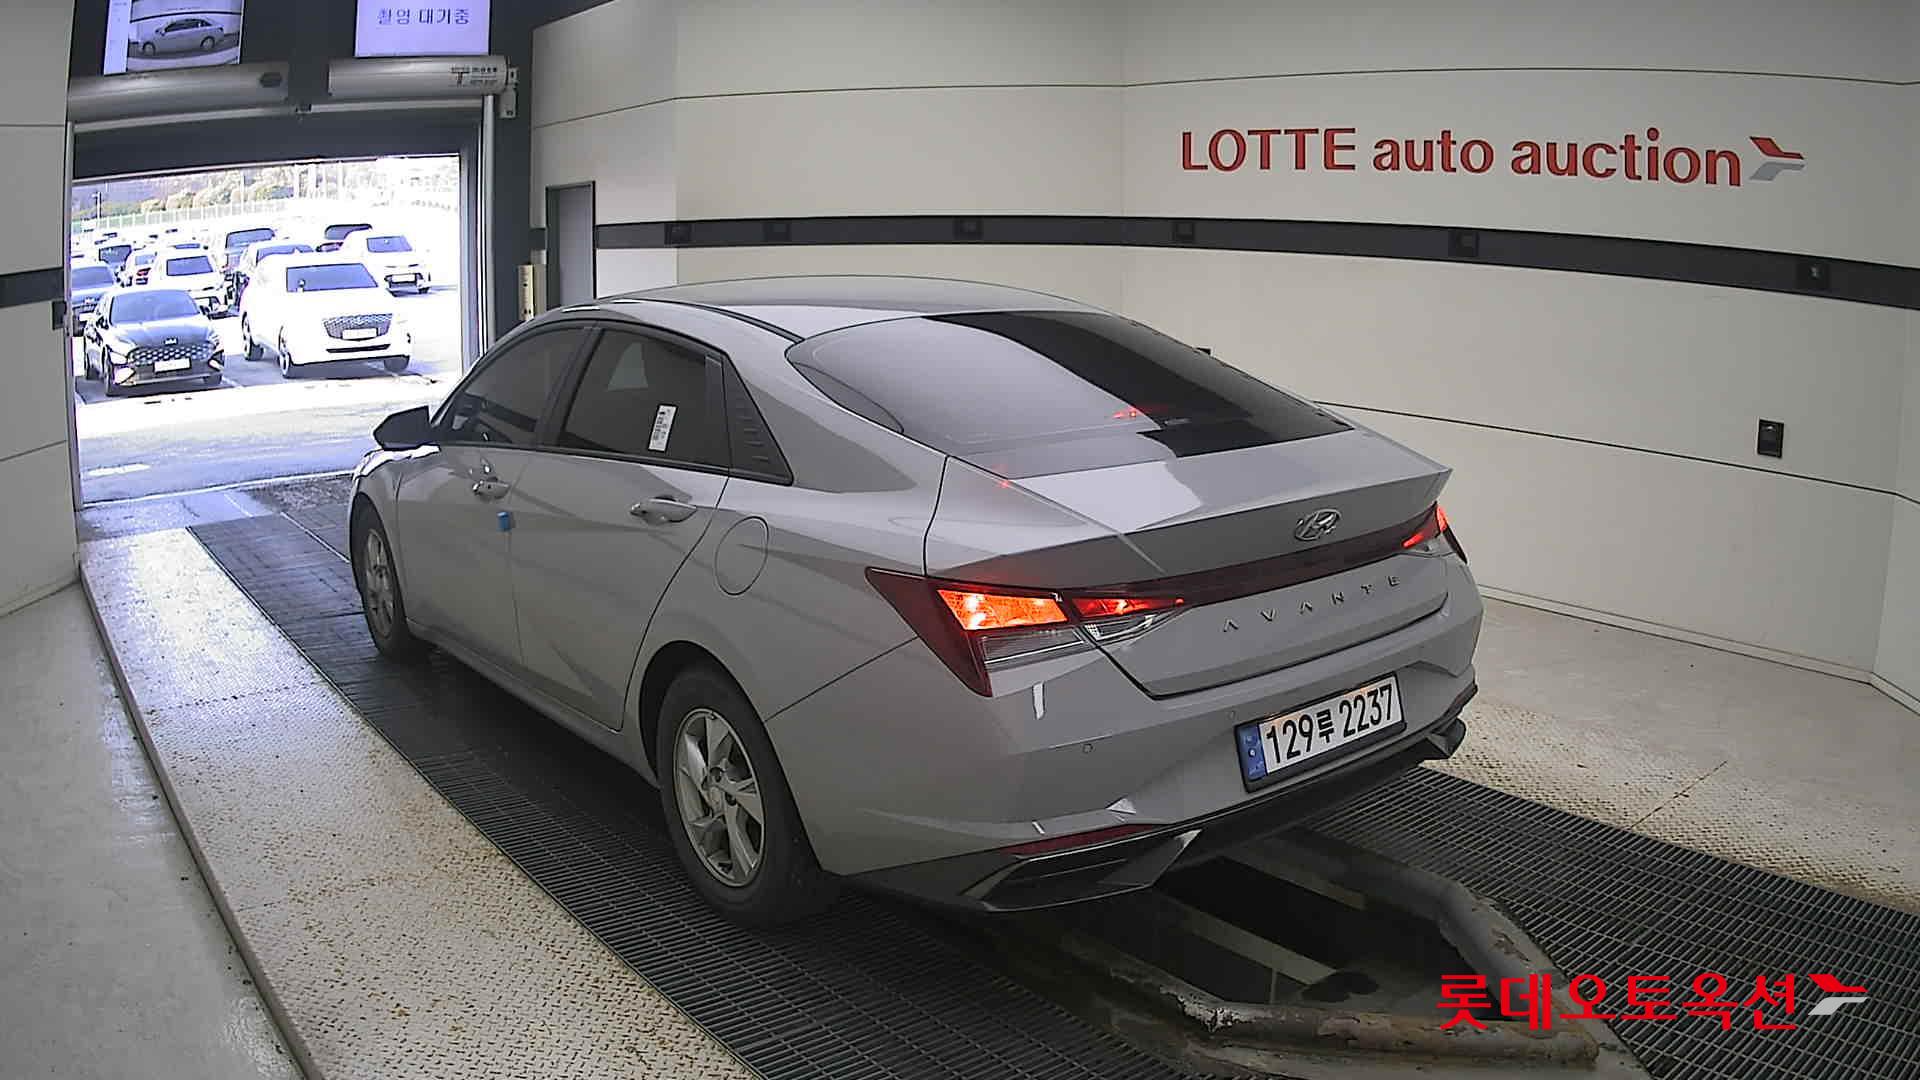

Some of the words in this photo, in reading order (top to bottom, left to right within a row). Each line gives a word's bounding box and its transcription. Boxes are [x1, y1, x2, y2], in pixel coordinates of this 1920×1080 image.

[418, 8, 470, 25] 대기중
[1181, 127, 1356, 172] LOTTE
[1372, 129, 1495, 174] auto
[1511, 127, 1742, 187] auction
[1222, 575, 1401, 633] AVANTE
[1265, 708, 1337, 764] 129루
[1338, 683, 1394, 739] 2237
